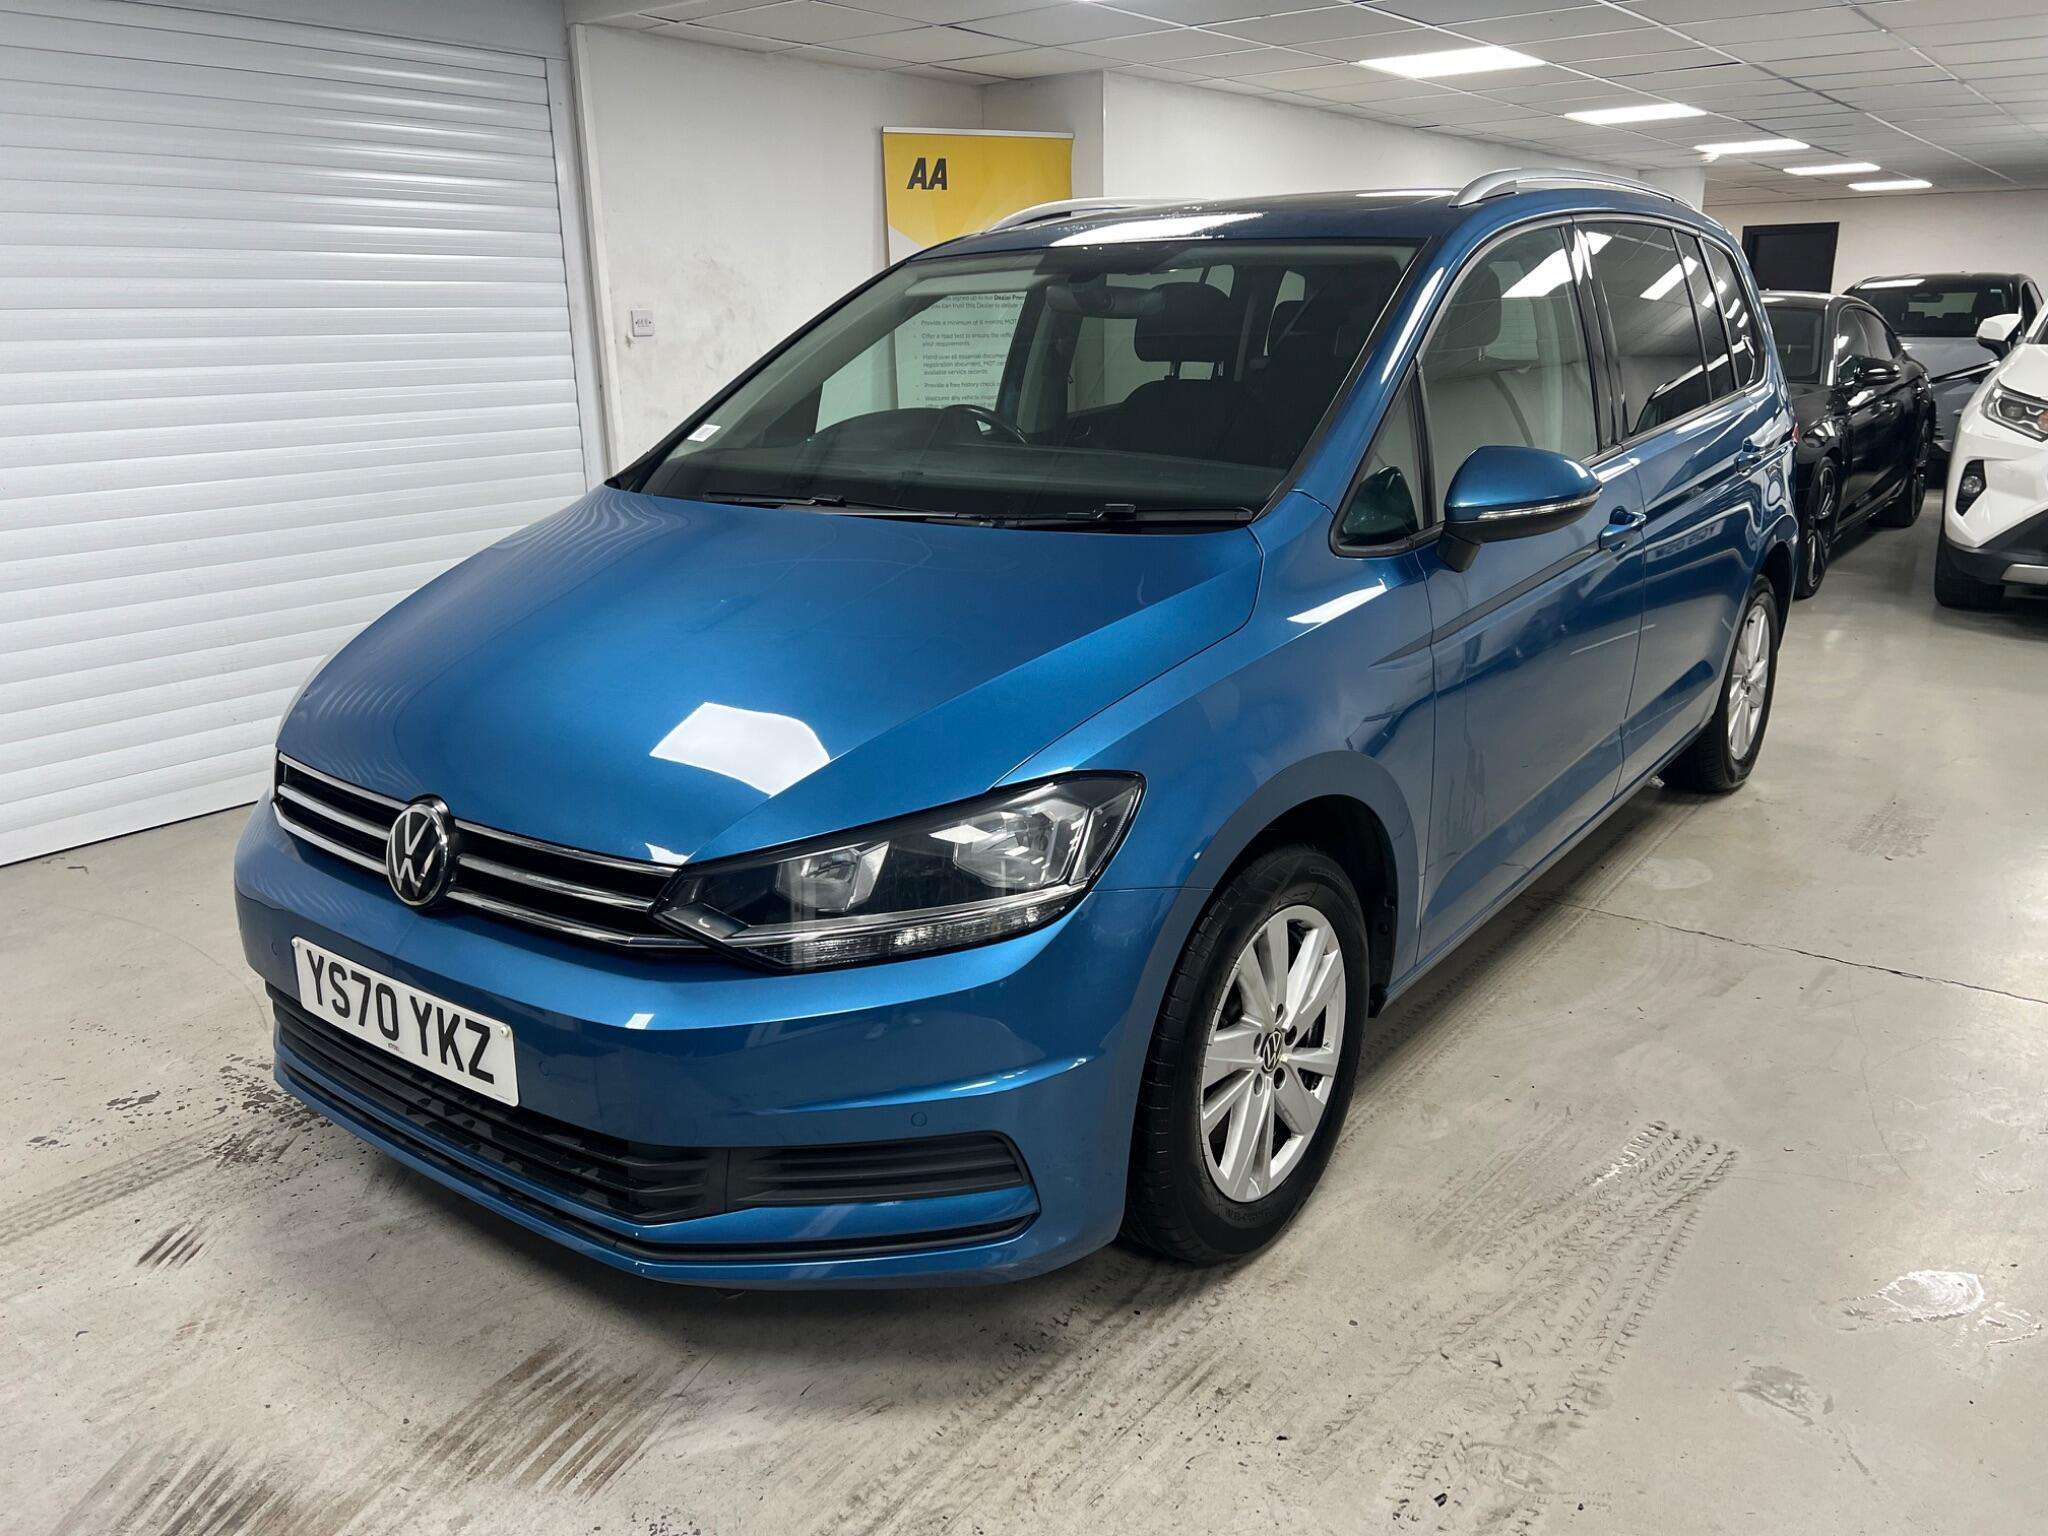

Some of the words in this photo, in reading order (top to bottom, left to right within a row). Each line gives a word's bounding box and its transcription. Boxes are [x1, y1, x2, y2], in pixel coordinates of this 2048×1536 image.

[907, 157, 948, 191] AA
[923, 361, 954, 369] registration
[961, 381, 979, 389] history
[306, 949, 400, 1042] YS70
[410, 995, 495, 1085] YKZ
